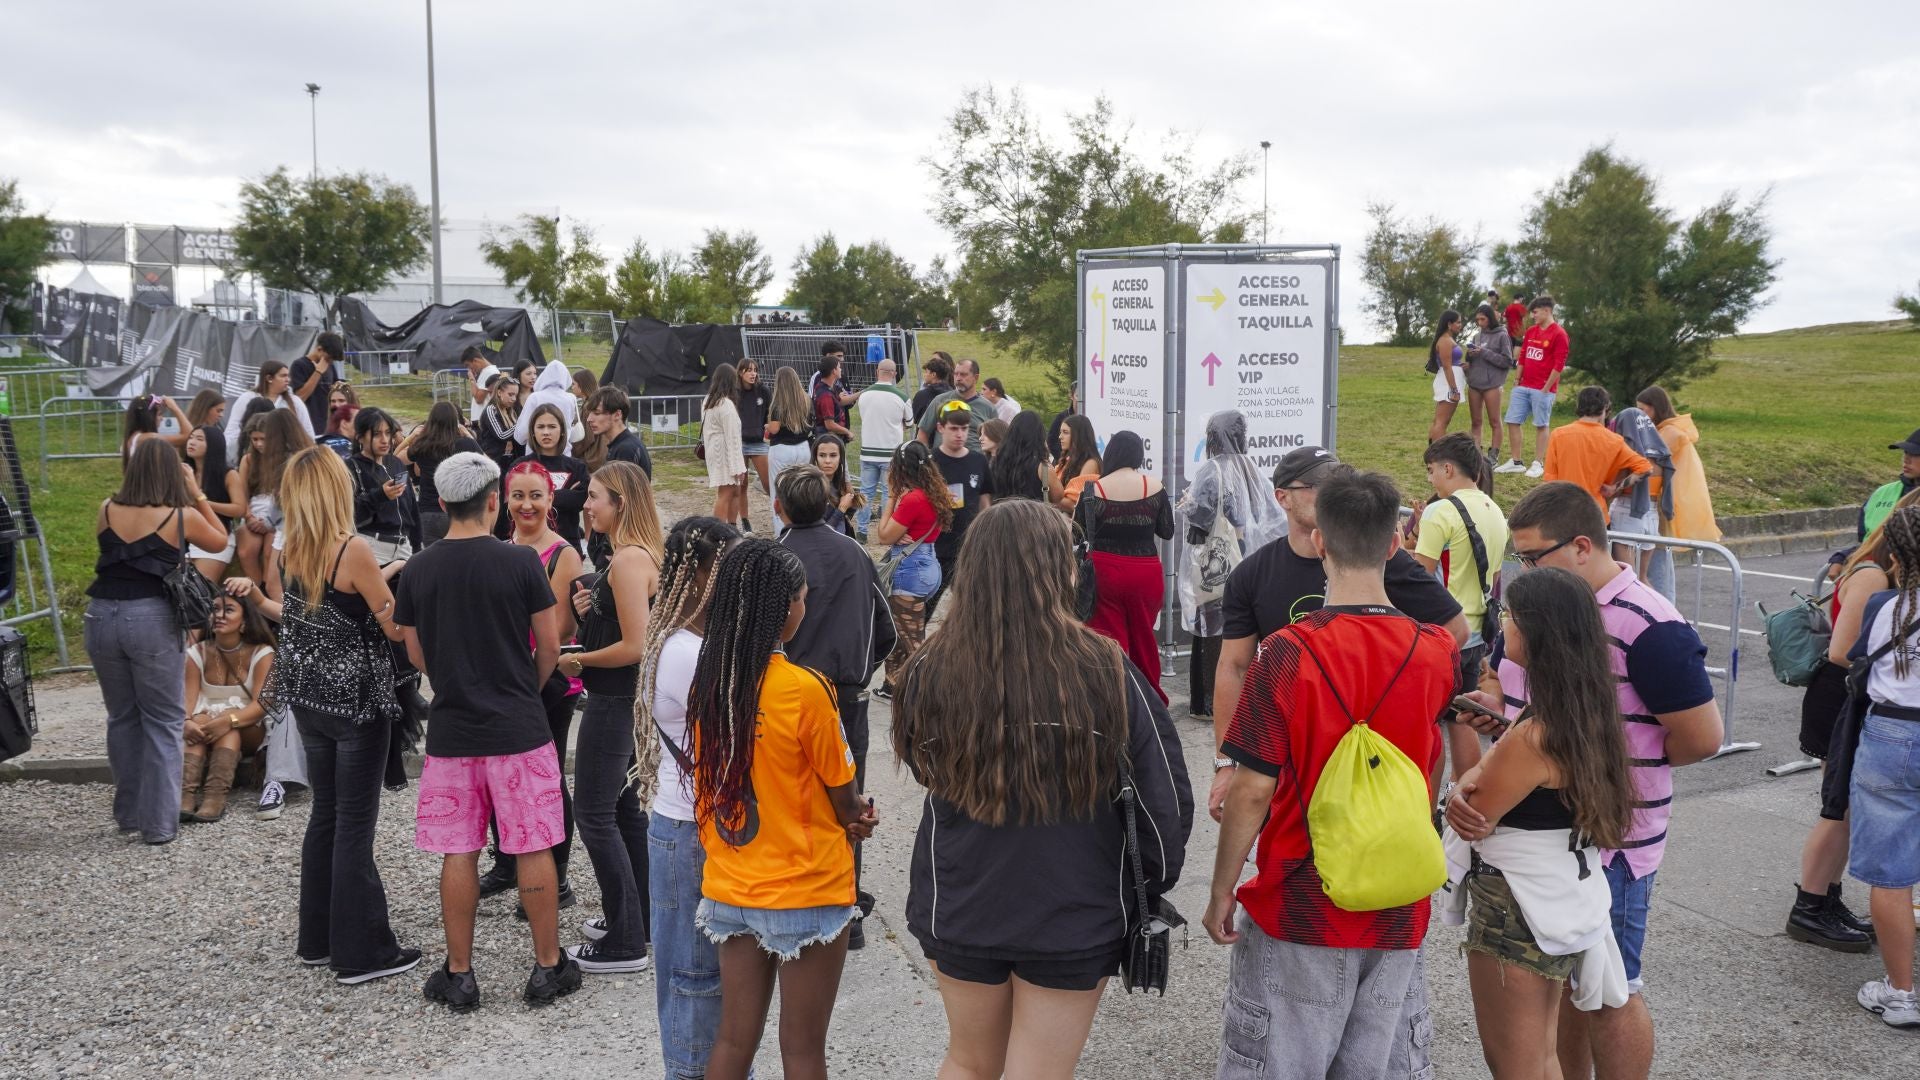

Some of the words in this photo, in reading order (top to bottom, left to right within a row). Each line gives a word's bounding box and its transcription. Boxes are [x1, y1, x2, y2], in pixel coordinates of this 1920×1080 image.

[183, 233, 240, 249] ACCES
[183, 247, 235, 260] GENER
[1112, 279, 1149, 292] ACCESO
[1238, 275, 1301, 289] ACCESO
[1112, 297, 1154, 309] GENERAL
[1238, 293, 1309, 307] GENERAL
[1112, 318, 1157, 333] TAQUILLA
[1238, 315, 1314, 332] TAQUILLA
[1111, 354, 1148, 368] ACCESO
[1237, 352, 1299, 366] ACCESO
[1111, 371, 1126, 384] VIP
[1238, 371, 1263, 384] VIP
[1110, 386, 1125, 395] ZONA
[1125, 388, 1148, 398] VILLAGE
[1238, 387, 1263, 396] ZONA
[1264, 386, 1300, 395] VILLAGE
[1110, 397, 1125, 406] ZONA
[1125, 399, 1158, 409] SONORAMA
[1237, 399, 1263, 407] ZONA
[1264, 397, 1314, 407] SONORAMA
[1110, 409, 1125, 418] ZONA
[1125, 410, 1151, 421] BLENDIO
[1264, 409, 1303, 418] BLENDIO
[1248, 434, 1304, 449] ARKING
